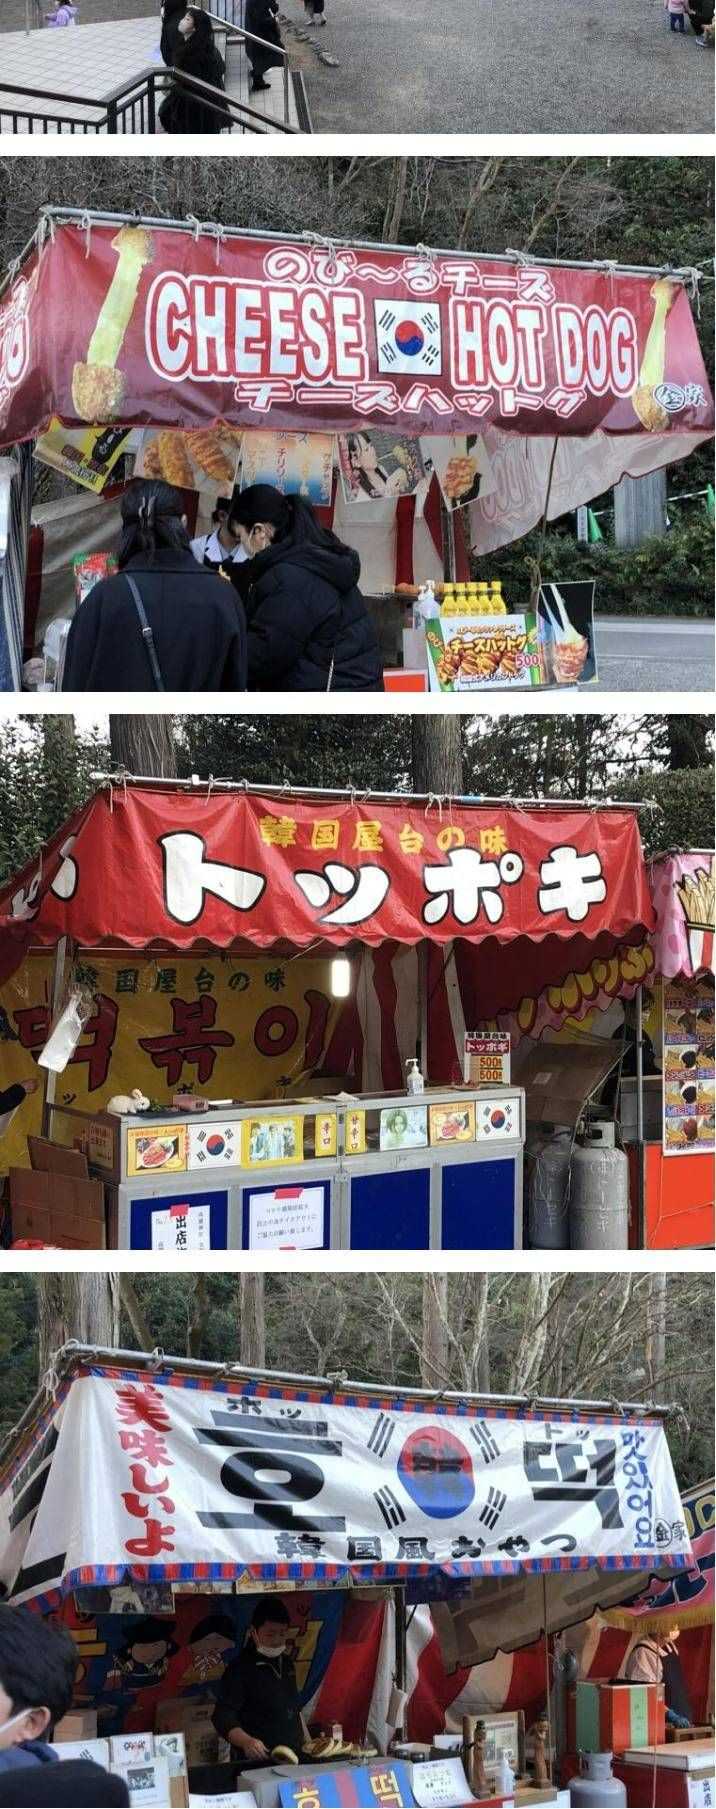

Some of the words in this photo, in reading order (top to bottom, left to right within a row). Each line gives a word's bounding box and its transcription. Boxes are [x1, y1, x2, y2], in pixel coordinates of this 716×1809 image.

[148, 274, 365, 385] CHEESE
[452, 298, 546, 390] HOT
[554, 304, 637, 396] DOG
[157, 829, 607, 926] トッポキ
[258, 815, 508, 855] 韓国屋台の味
[175, 1215, 187, 1250] 出店
[115, 1383, 175, 1557] 美味しいよ
[621, 1429, 656, 1549] 맛있어요
[274, 1531, 578, 1562] 韓国風おやつ
